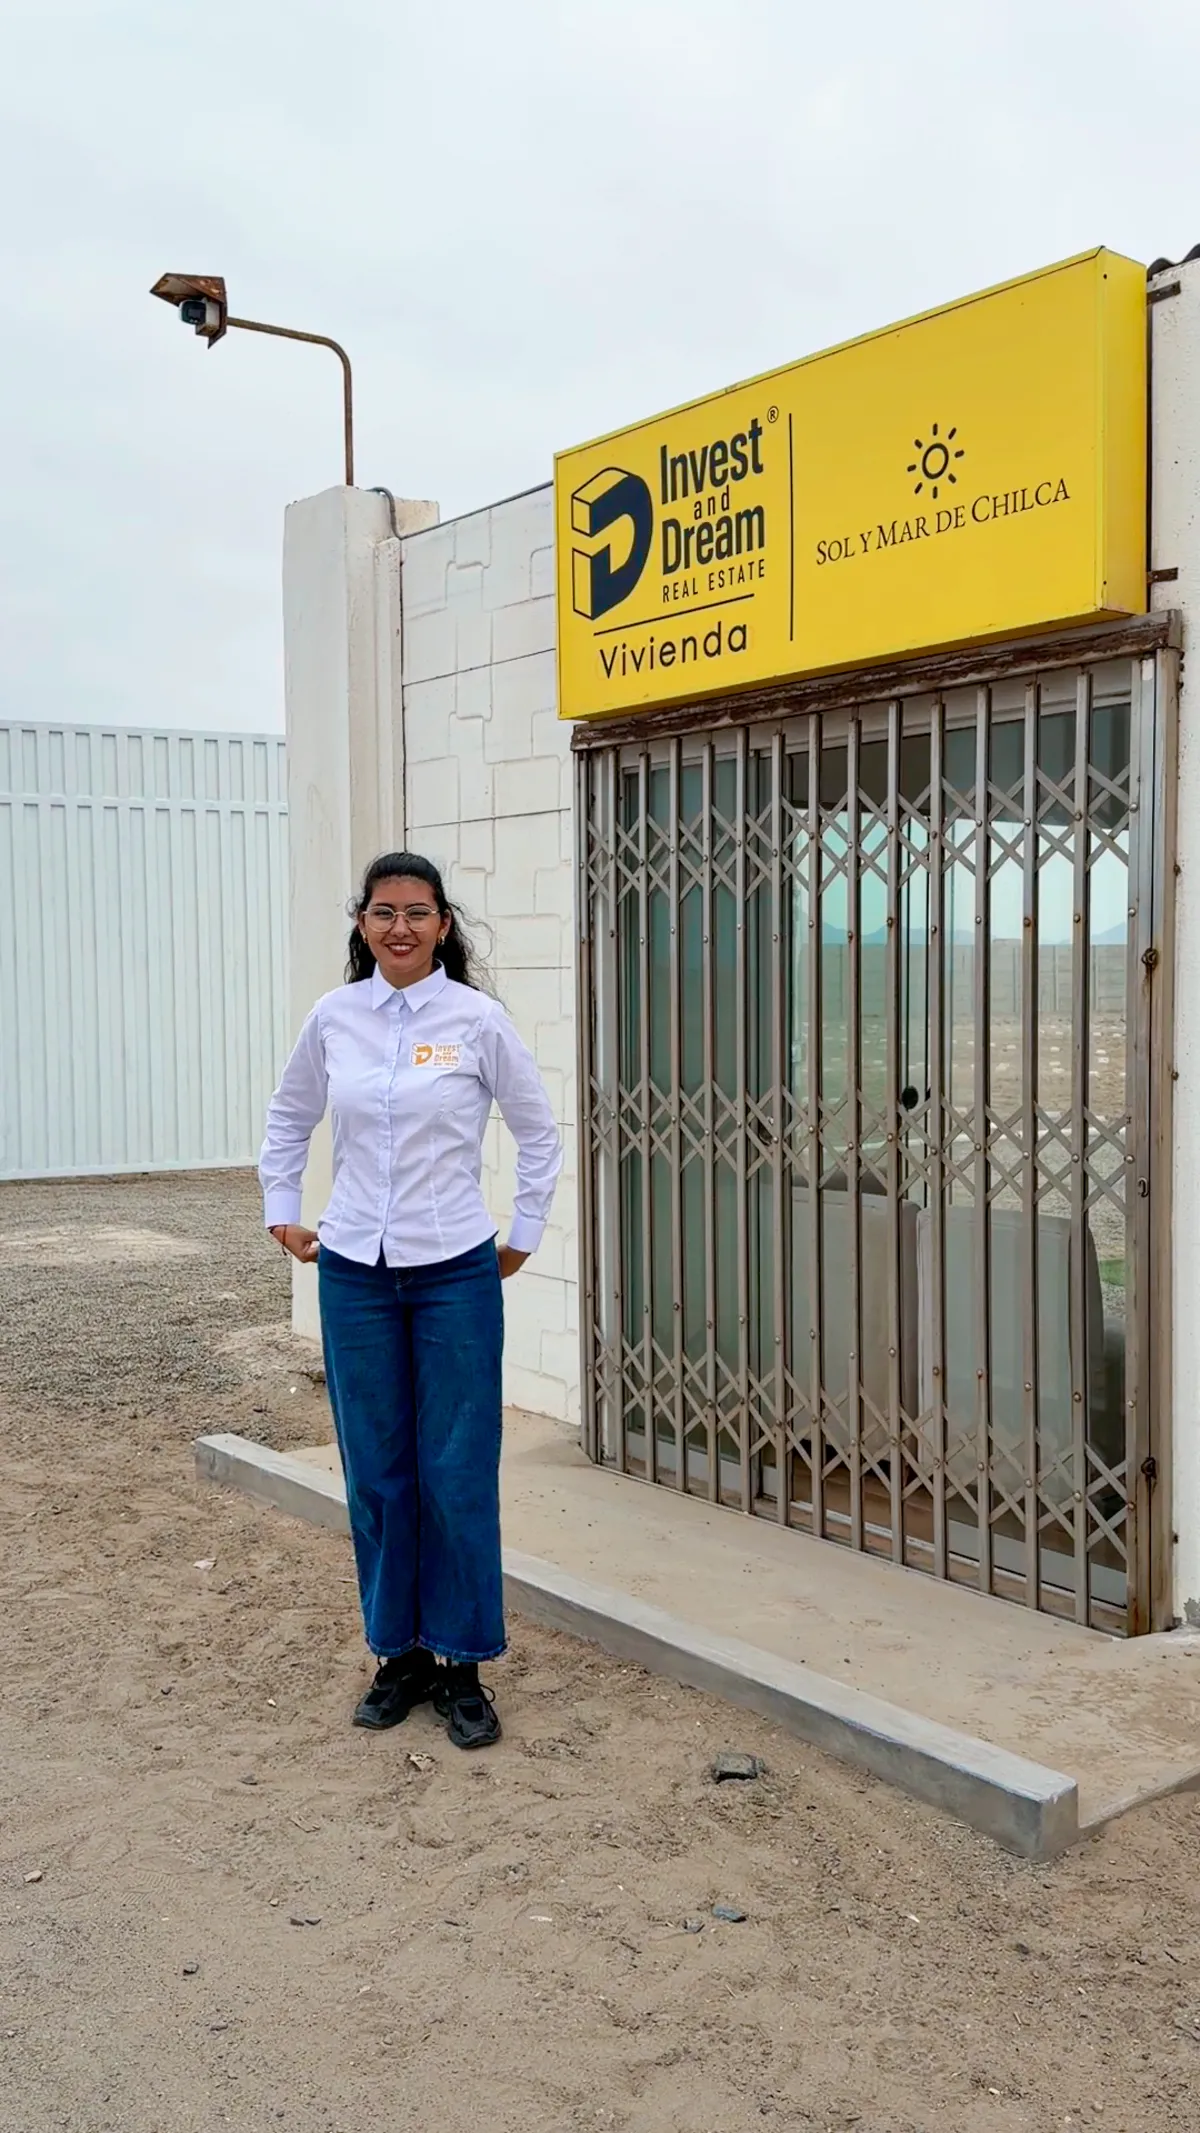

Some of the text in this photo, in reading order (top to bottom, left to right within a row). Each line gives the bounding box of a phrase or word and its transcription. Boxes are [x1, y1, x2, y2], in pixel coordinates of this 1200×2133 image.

[660, 418, 764, 505] Invest
[693, 485, 730, 520] and
[815, 478, 1071, 566] SOL Y MAR DE CHILCA
[662, 504, 765, 576] Dream
[662, 559, 766, 603] REAL ESTATE
[600, 621, 748, 680] Vivienda
